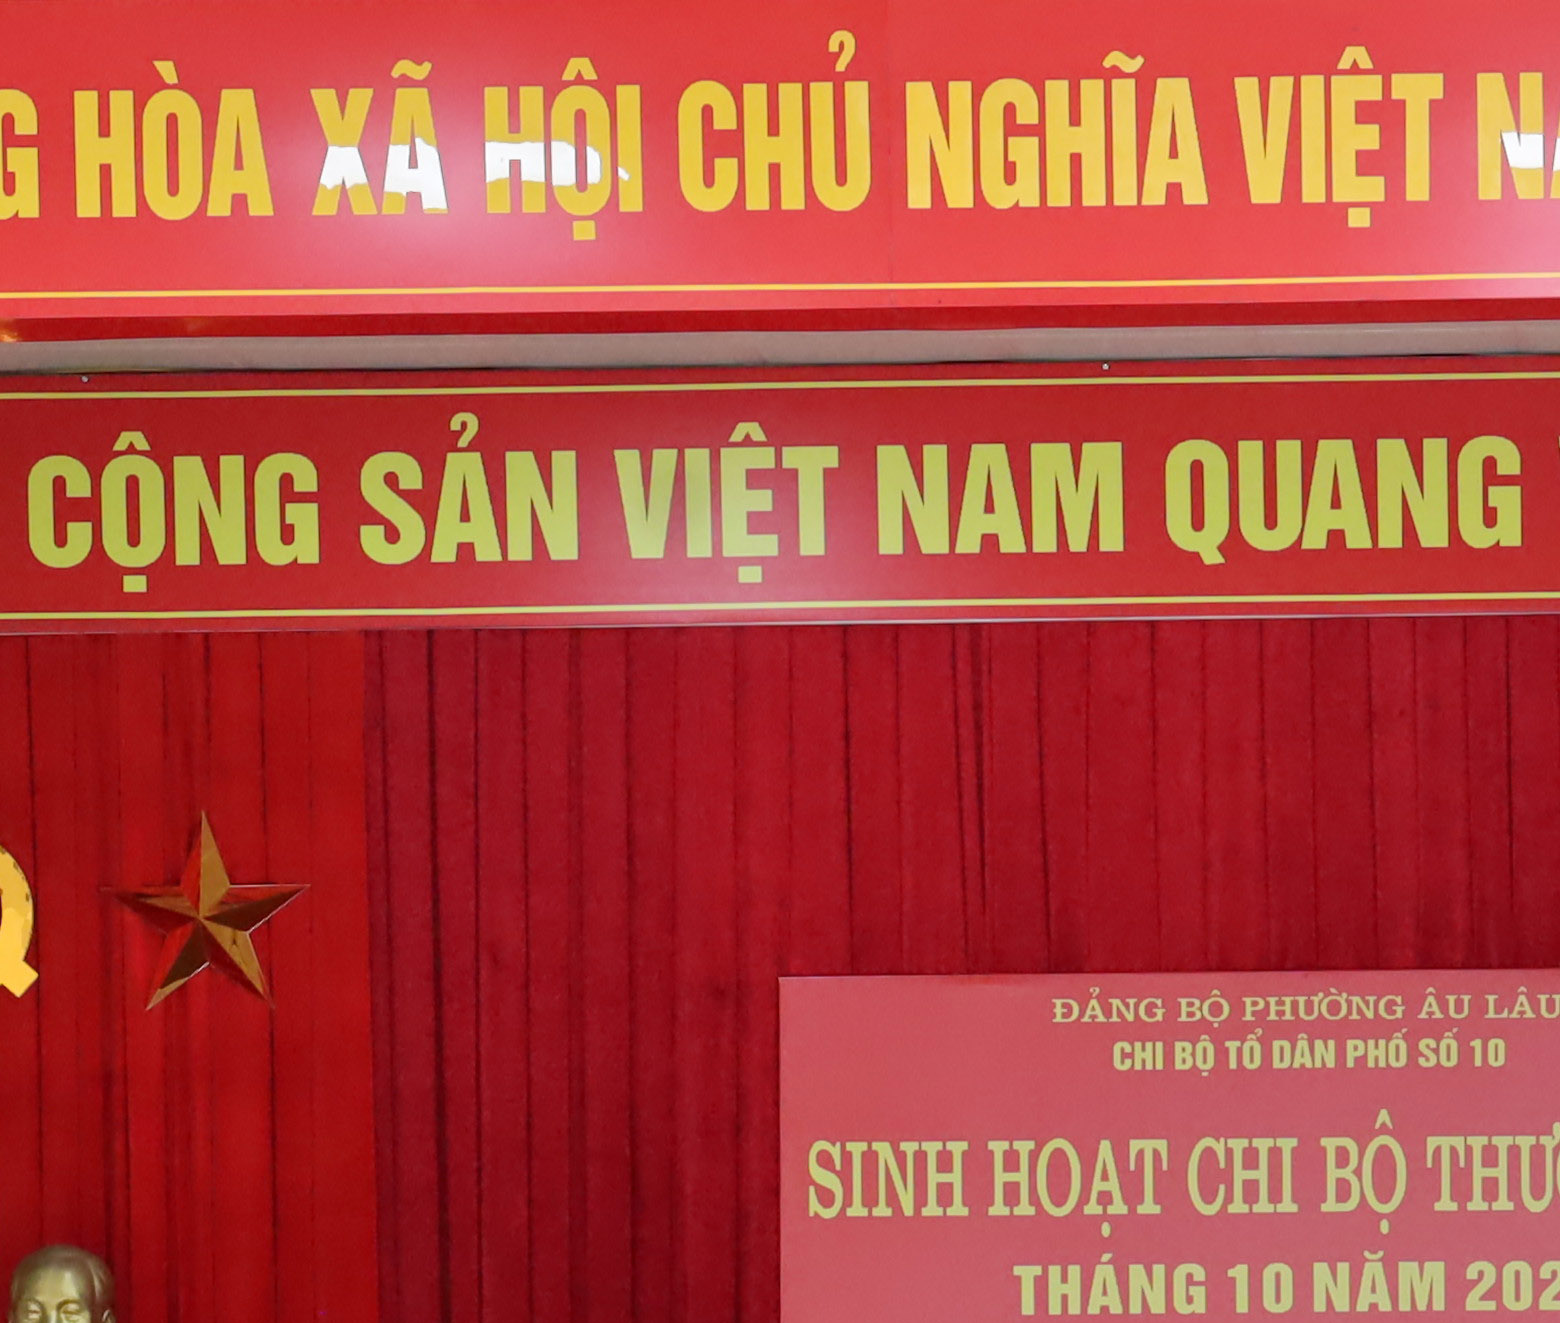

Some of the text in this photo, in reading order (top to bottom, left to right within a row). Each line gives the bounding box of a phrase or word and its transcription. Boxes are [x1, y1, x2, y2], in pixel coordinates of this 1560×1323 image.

[74, 61, 274, 219] HÒA
[312, 60, 447, 215] XÃ
[485, 58, 643, 240] HỘI
[678, 31, 871, 211] CHỦ
[907, 52, 1208, 208] NGHĨA
[1235, 47, 1443, 226] VIỆT
[28, 432, 320, 592] CỘNG
[360, 413, 578, 564] SẢN
[614, 422, 839, 581] VIỆT
[877, 442, 1124, 554] NAM
[1165, 436, 1523, 565] QUANG
[1052, 987, 1166, 1022] ĐẢNG
[1178, 990, 1230, 1027] BỘ
[1242, 988, 1405, 1020] PHƯỜNG
[1418, 987, 1471, 1018] ÂU
[1113, 1030, 1505, 1076] CHI BỘ TỔ DÂN PHỐ SỐ 10
[809, 1140, 969, 1219] SINH
[988, 1138, 1168, 1237] HOẠT
[1188, 1137, 1298, 1216] CHI
[1320, 1109, 1407, 1234] BỘ
[1013, 1253, 1206, 1315] THÁNG
[1227, 1262, 1293, 1313] 10
[1313, 1250, 1445, 1312] NĂM
